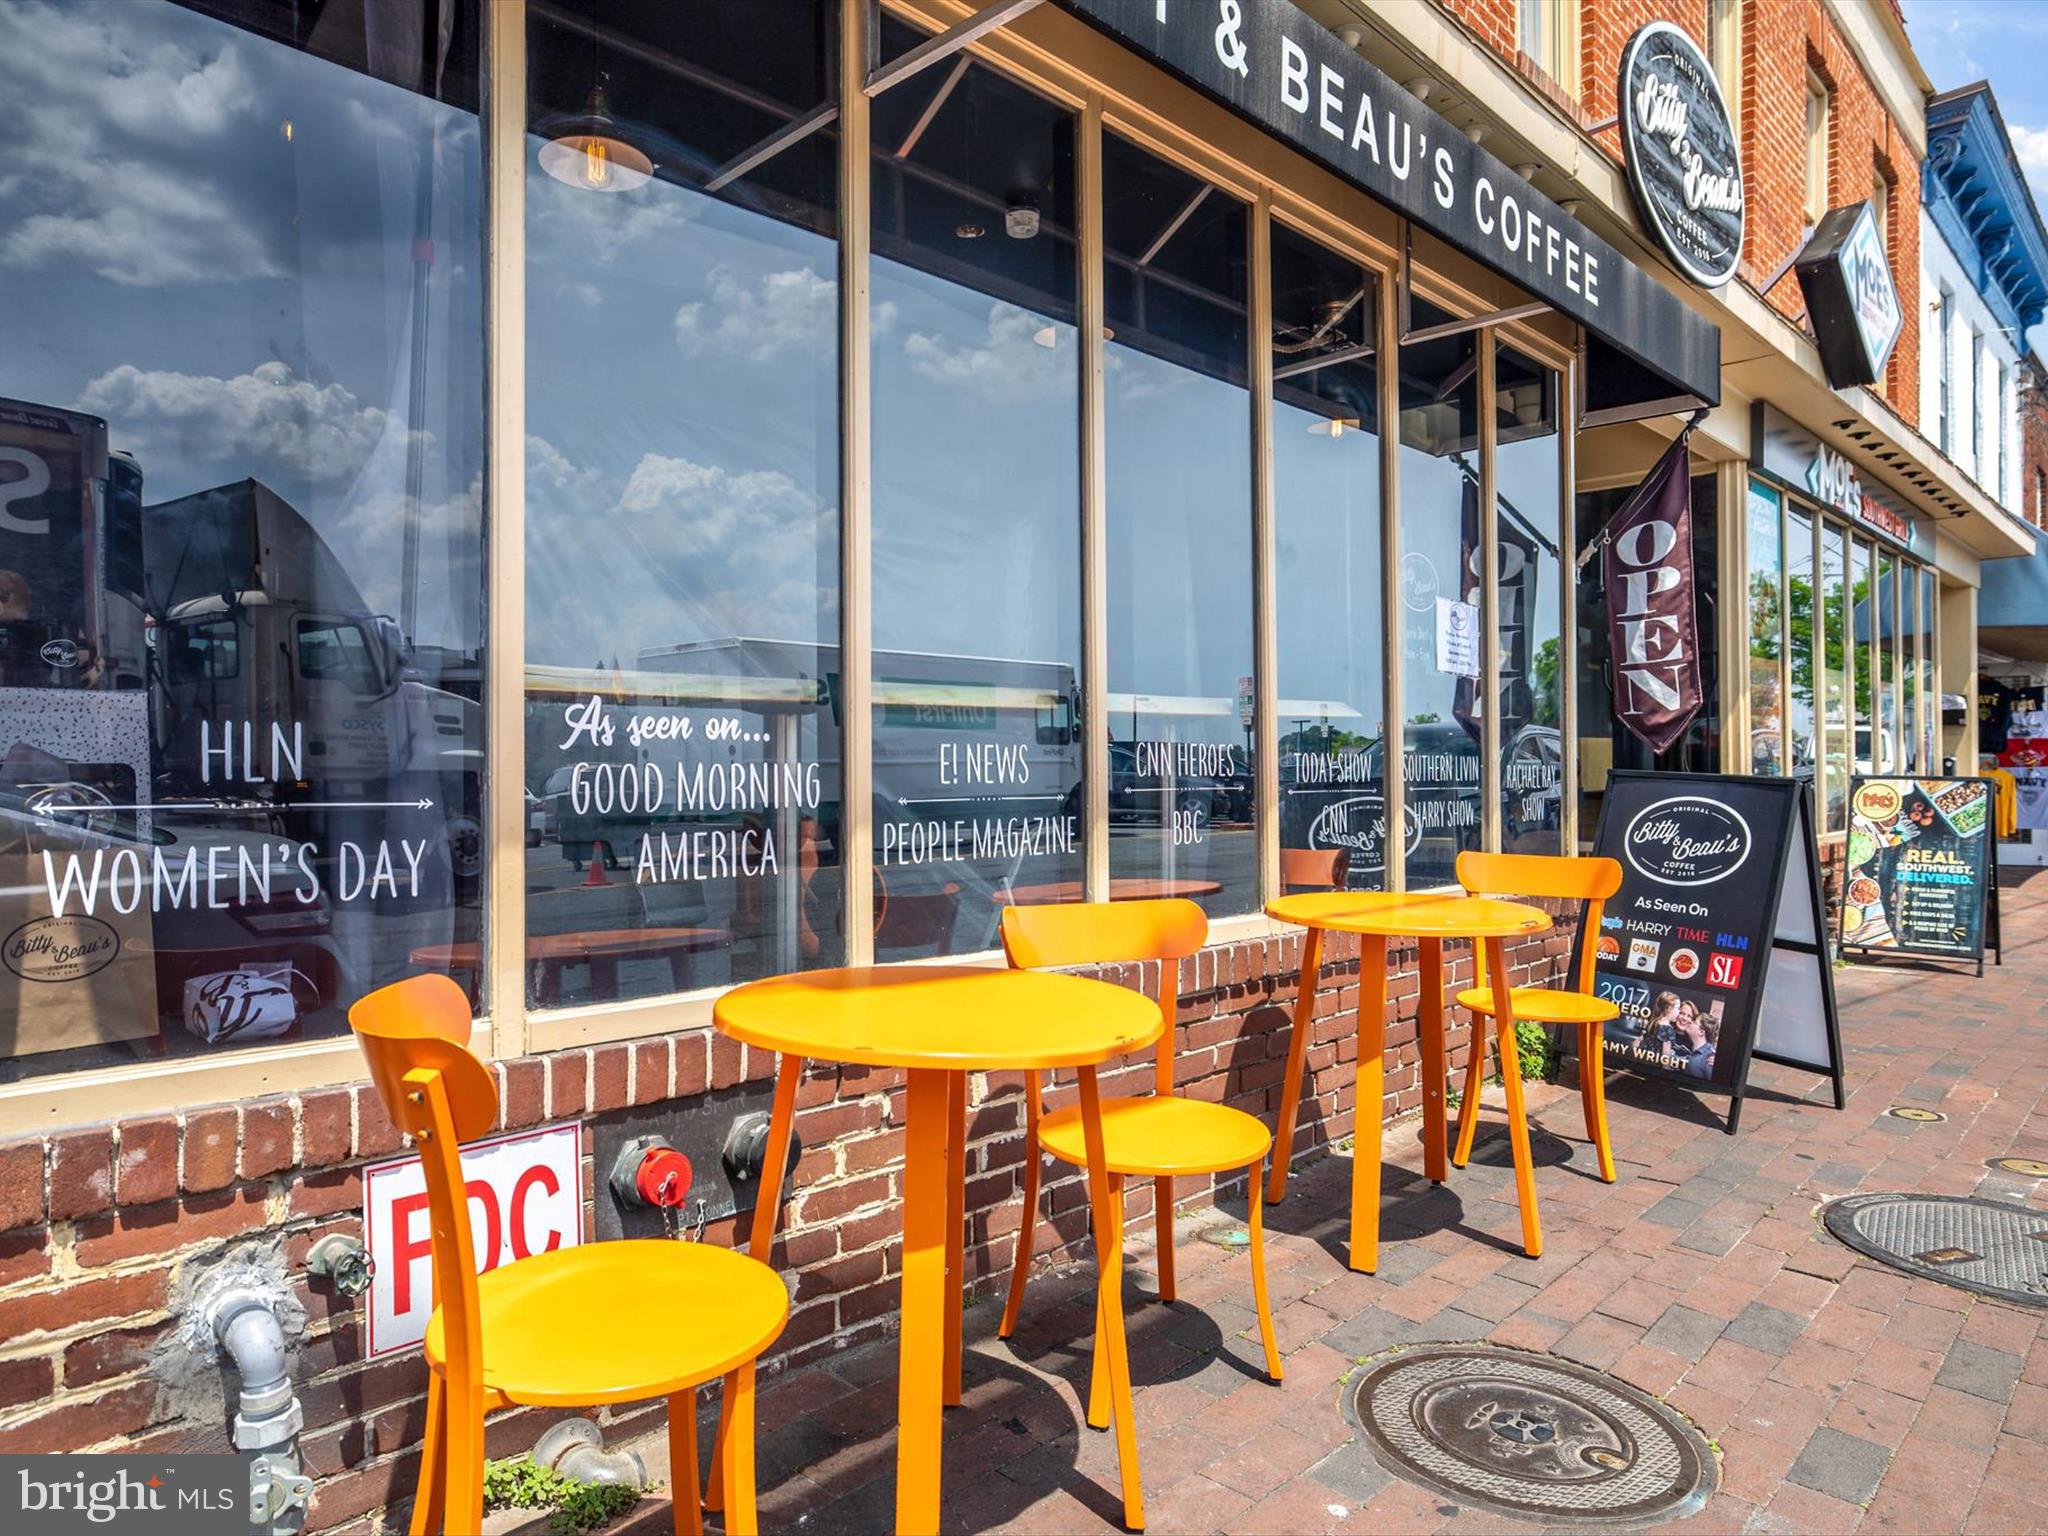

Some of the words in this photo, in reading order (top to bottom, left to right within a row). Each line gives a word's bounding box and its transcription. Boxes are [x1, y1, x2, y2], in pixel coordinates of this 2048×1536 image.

[1673, 53, 1711, 101] ORIGINAL
[1215, 0, 1248, 79] &
[1281, 35, 1455, 210] BEAU'S
[1475, 177, 1600, 307] COFFEE
[1636, 73, 1688, 156] Bitty
[1683, 153, 1743, 213] Beau's
[1676, 209, 1708, 247] COFFEE
[1676, 226, 1691, 250] EST
[1616, 520, 1688, 715] OPEN
[559, 695, 616, 750] As
[626, 714, 693, 748] seen
[705, 715, 770, 746] on...
[201, 719, 303, 784] HLN
[940, 743, 958, 785] E!
[966, 743, 1030, 785] NEWS
[1136, 743, 1172, 779] CNN
[1177, 743, 1235, 778] HEROES
[1294, 753, 1334, 784] TODAY
[1337, 753, 1373, 783] SHOW
[1403, 754, 1453, 782] SOUTHERN
[1455, 755, 1480, 782] LIVIN
[1506, 764, 1541, 790] RACHAEL
[1542, 764, 1557, 790] RAY
[572, 762, 664, 816] GOOD
[677, 762, 821, 811] MORNING
[1321, 804, 1348, 835] CNN
[1414, 800, 1446, 829] HARRY
[1447, 799, 1475, 828] SHOW
[1521, 797, 1546, 823] SHOW
[1672, 806, 1711, 815] ORIGINAL
[883, 819, 965, 867] PEOPLE
[972, 815, 1077, 861] MAGAZINE
[1173, 810, 1204, 847] BBC
[1633, 819, 1681, 845] Bitty
[1672, 836, 1681, 846] &
[636, 828, 779, 885] AMERICA
[1672, 833, 1741, 861] Beau's
[1907, 849, 1966, 865] REAL.
[42, 841, 320, 919] WOMEN'S
[338, 839, 426, 902] DAY
[1660, 868, 1675, 876] EST
[1663, 861, 1696, 871] COFFEE
[1896, 862, 1975, 875] SOUTHWEST.
[1896, 871, 1974, 885] DELIVERED.
[1634, 895, 1652, 909] As
[1653, 898, 1687, 914] Seen
[1688, 903, 1709, 918] On
[9, 934, 54, 959] Bitty
[54, 935, 111, 964] Beau's
[1626, 919, 1672, 937] HARRY
[1676, 925, 1712, 944] TIME
[1716, 932, 1749, 950] HLN
[1632, 942, 1657, 957] GMA
[1596, 950, 1620, 962] ODAY
[1710, 955, 1737, 986] SL
[1600, 981, 1649, 1007] 2017
[1602, 1040, 1629, 1056] AMY
[1633, 1046, 1690, 1070] WRIGHT
[392, 1163, 562, 1318] FDC
